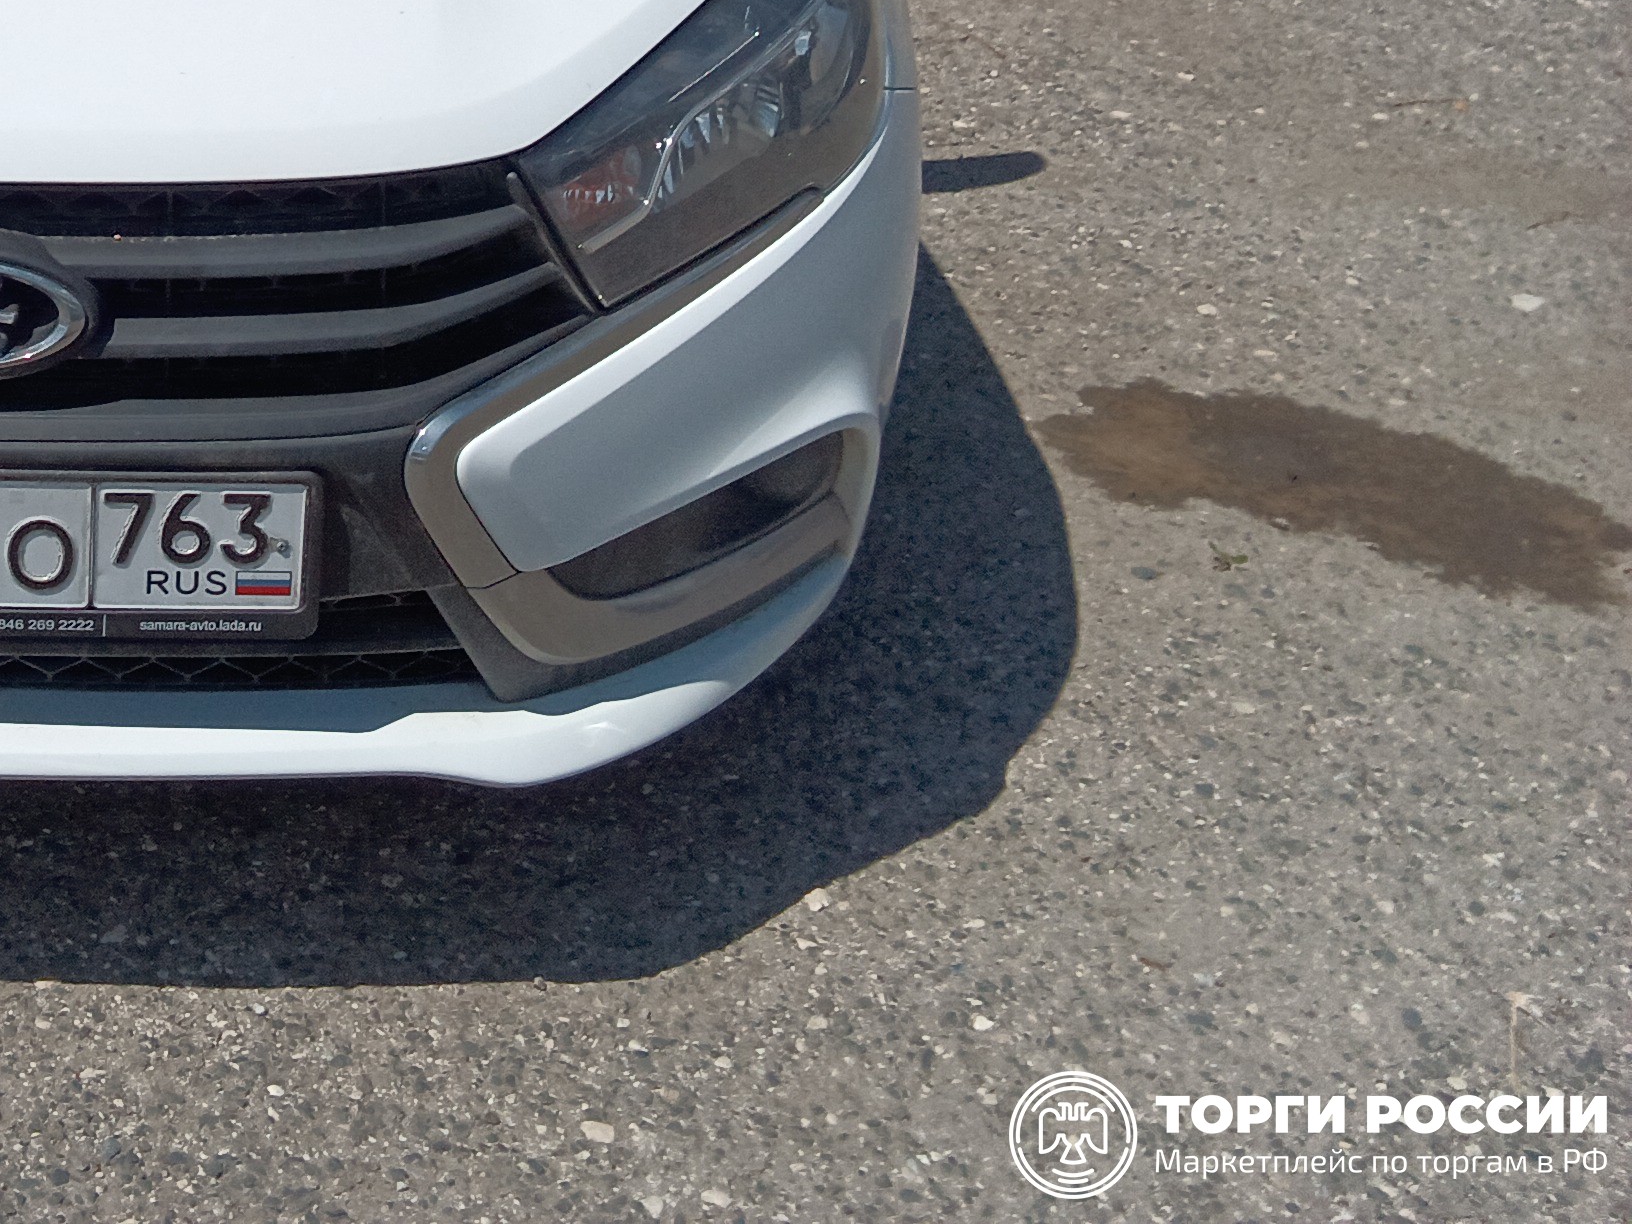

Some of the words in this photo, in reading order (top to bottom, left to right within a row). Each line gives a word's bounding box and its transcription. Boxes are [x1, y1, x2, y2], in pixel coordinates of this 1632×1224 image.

[104, 490, 269, 566] 763
[146, 569, 228, 597] RUS
[28, 618, 56, 631] 269
[58, 619, 95, 632] 2222
[139, 620, 263, 633] samara-avto.lada.ru
